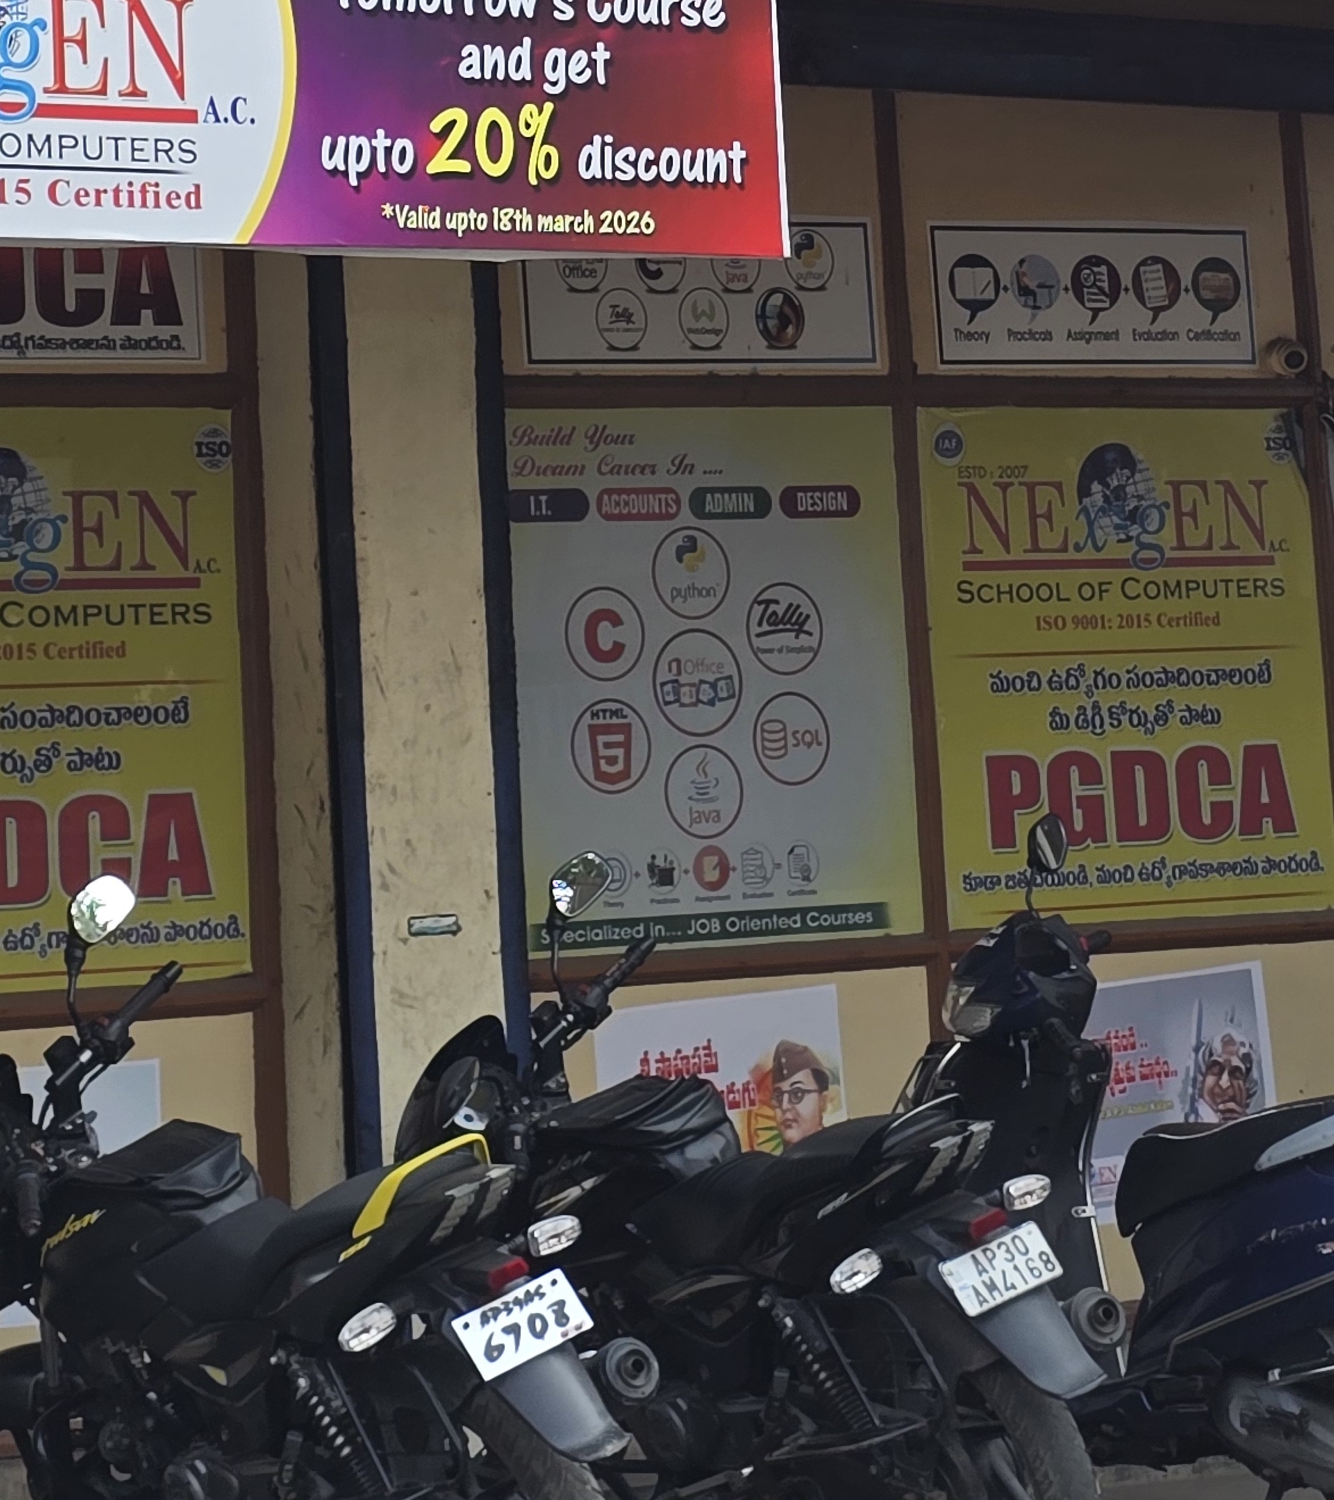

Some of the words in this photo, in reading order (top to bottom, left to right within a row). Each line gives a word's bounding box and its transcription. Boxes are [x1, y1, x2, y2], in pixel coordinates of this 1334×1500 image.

[321, 129, 415, 186] upto
[425, 102, 560, 186] 20%
[578, 135, 747, 186] discount
[446, 208, 488, 237] upto
[493, 207, 533, 233] 18th
[537, 211, 594, 235] march
[599, 211, 655, 236] 2026
[529, 496, 552, 517] I.T.
[601, 494, 677, 516] ACCOUNTS
[705, 493, 755, 514] ADMIN
[797, 492, 848, 513] DESIGN
[971, 1235, 1029, 1277] AP30
[971, 1251, 1056, 1308] AM4168
